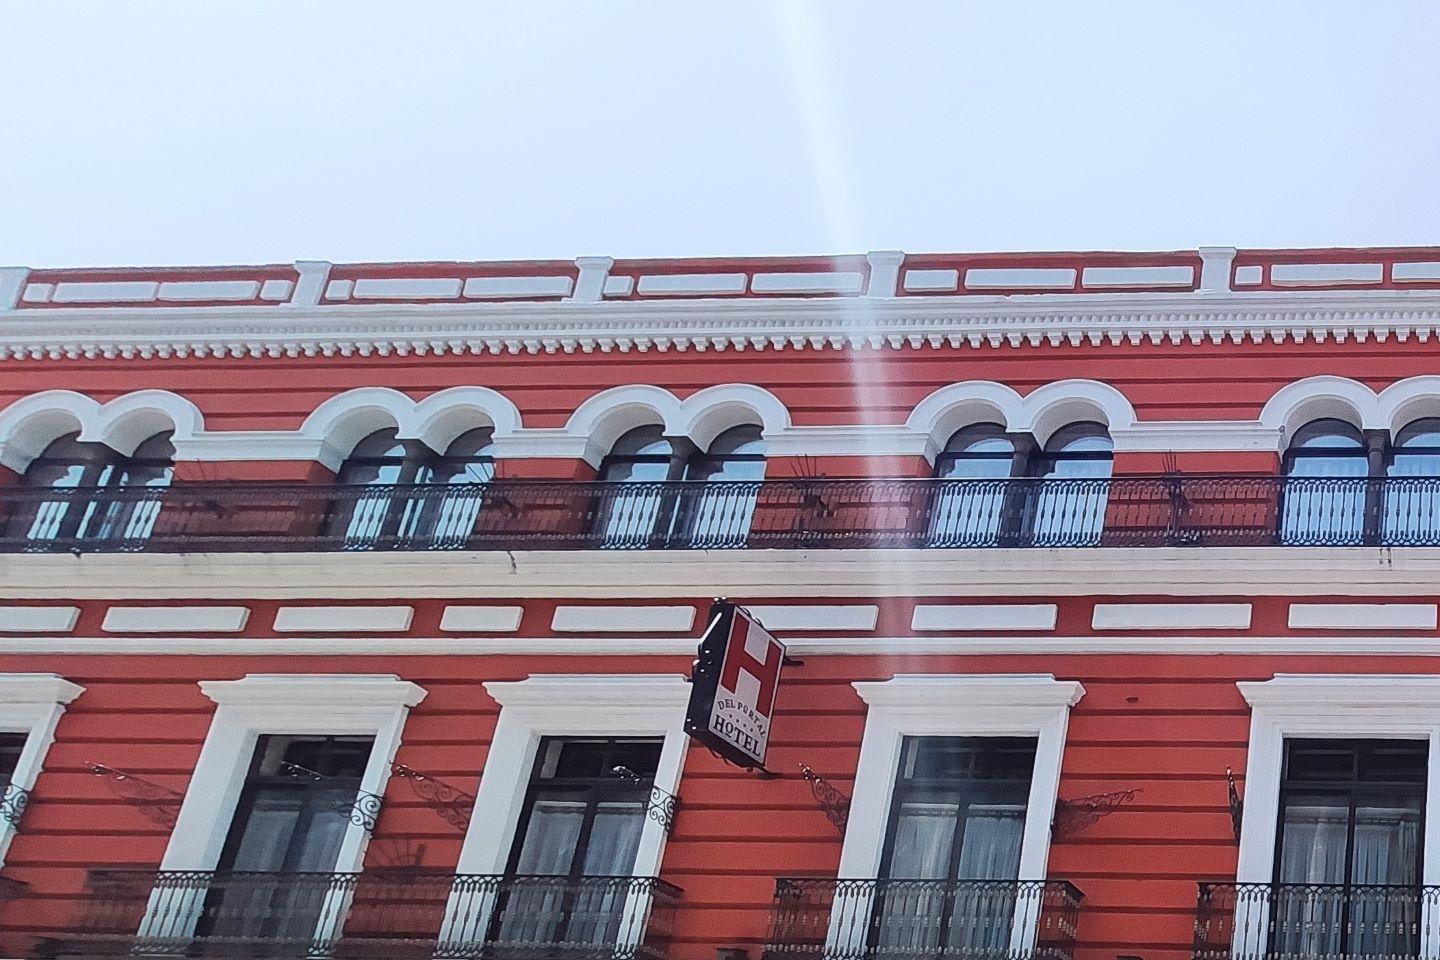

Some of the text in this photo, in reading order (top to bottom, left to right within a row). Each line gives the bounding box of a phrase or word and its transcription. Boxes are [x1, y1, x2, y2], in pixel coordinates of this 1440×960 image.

[721, 612, 782, 719] H
[713, 714, 761, 757] HOTEL
[717, 698, 767, 739] DEL PORTAL
